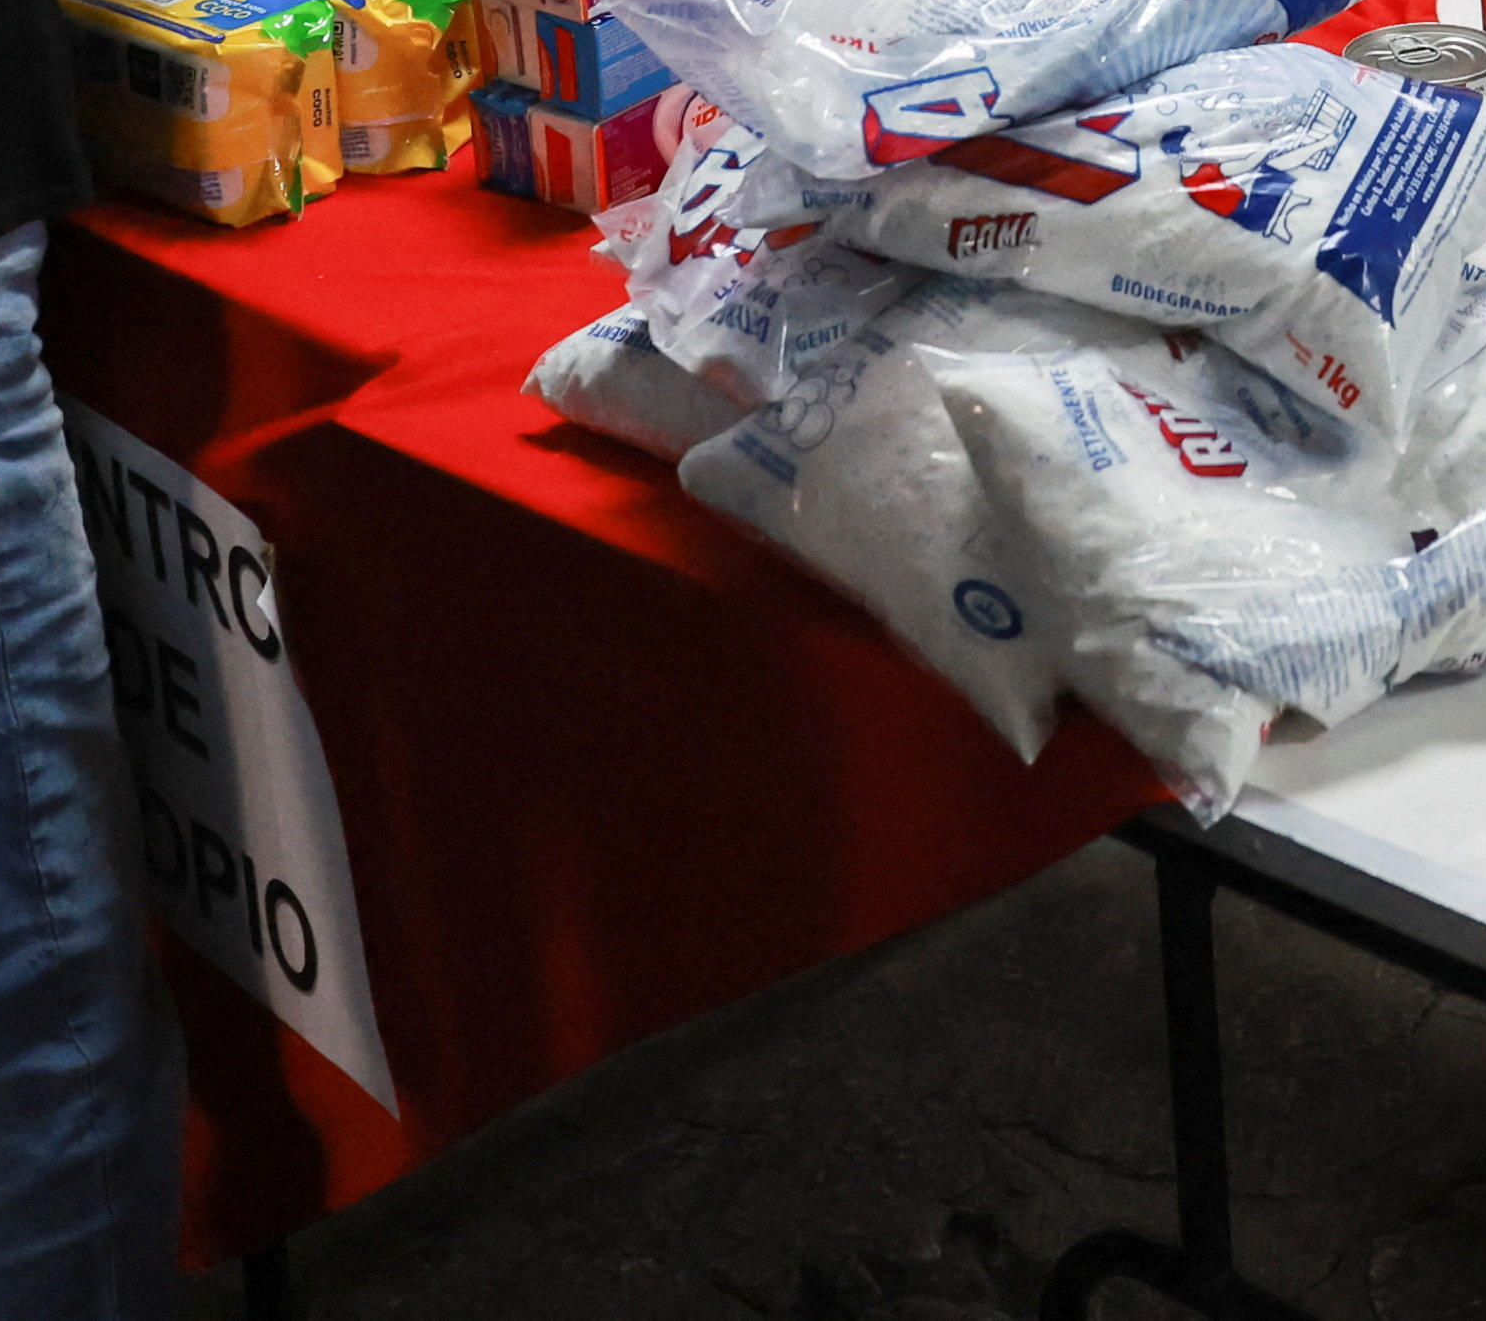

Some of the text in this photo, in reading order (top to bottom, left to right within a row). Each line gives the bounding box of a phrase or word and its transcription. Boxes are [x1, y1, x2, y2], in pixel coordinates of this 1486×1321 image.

[199, 0, 252, 20] COCO
[948, 211, 1042, 260] ROMA
[1318, 354, 1361, 410] 1kg
[105, 607, 209, 761] DE
